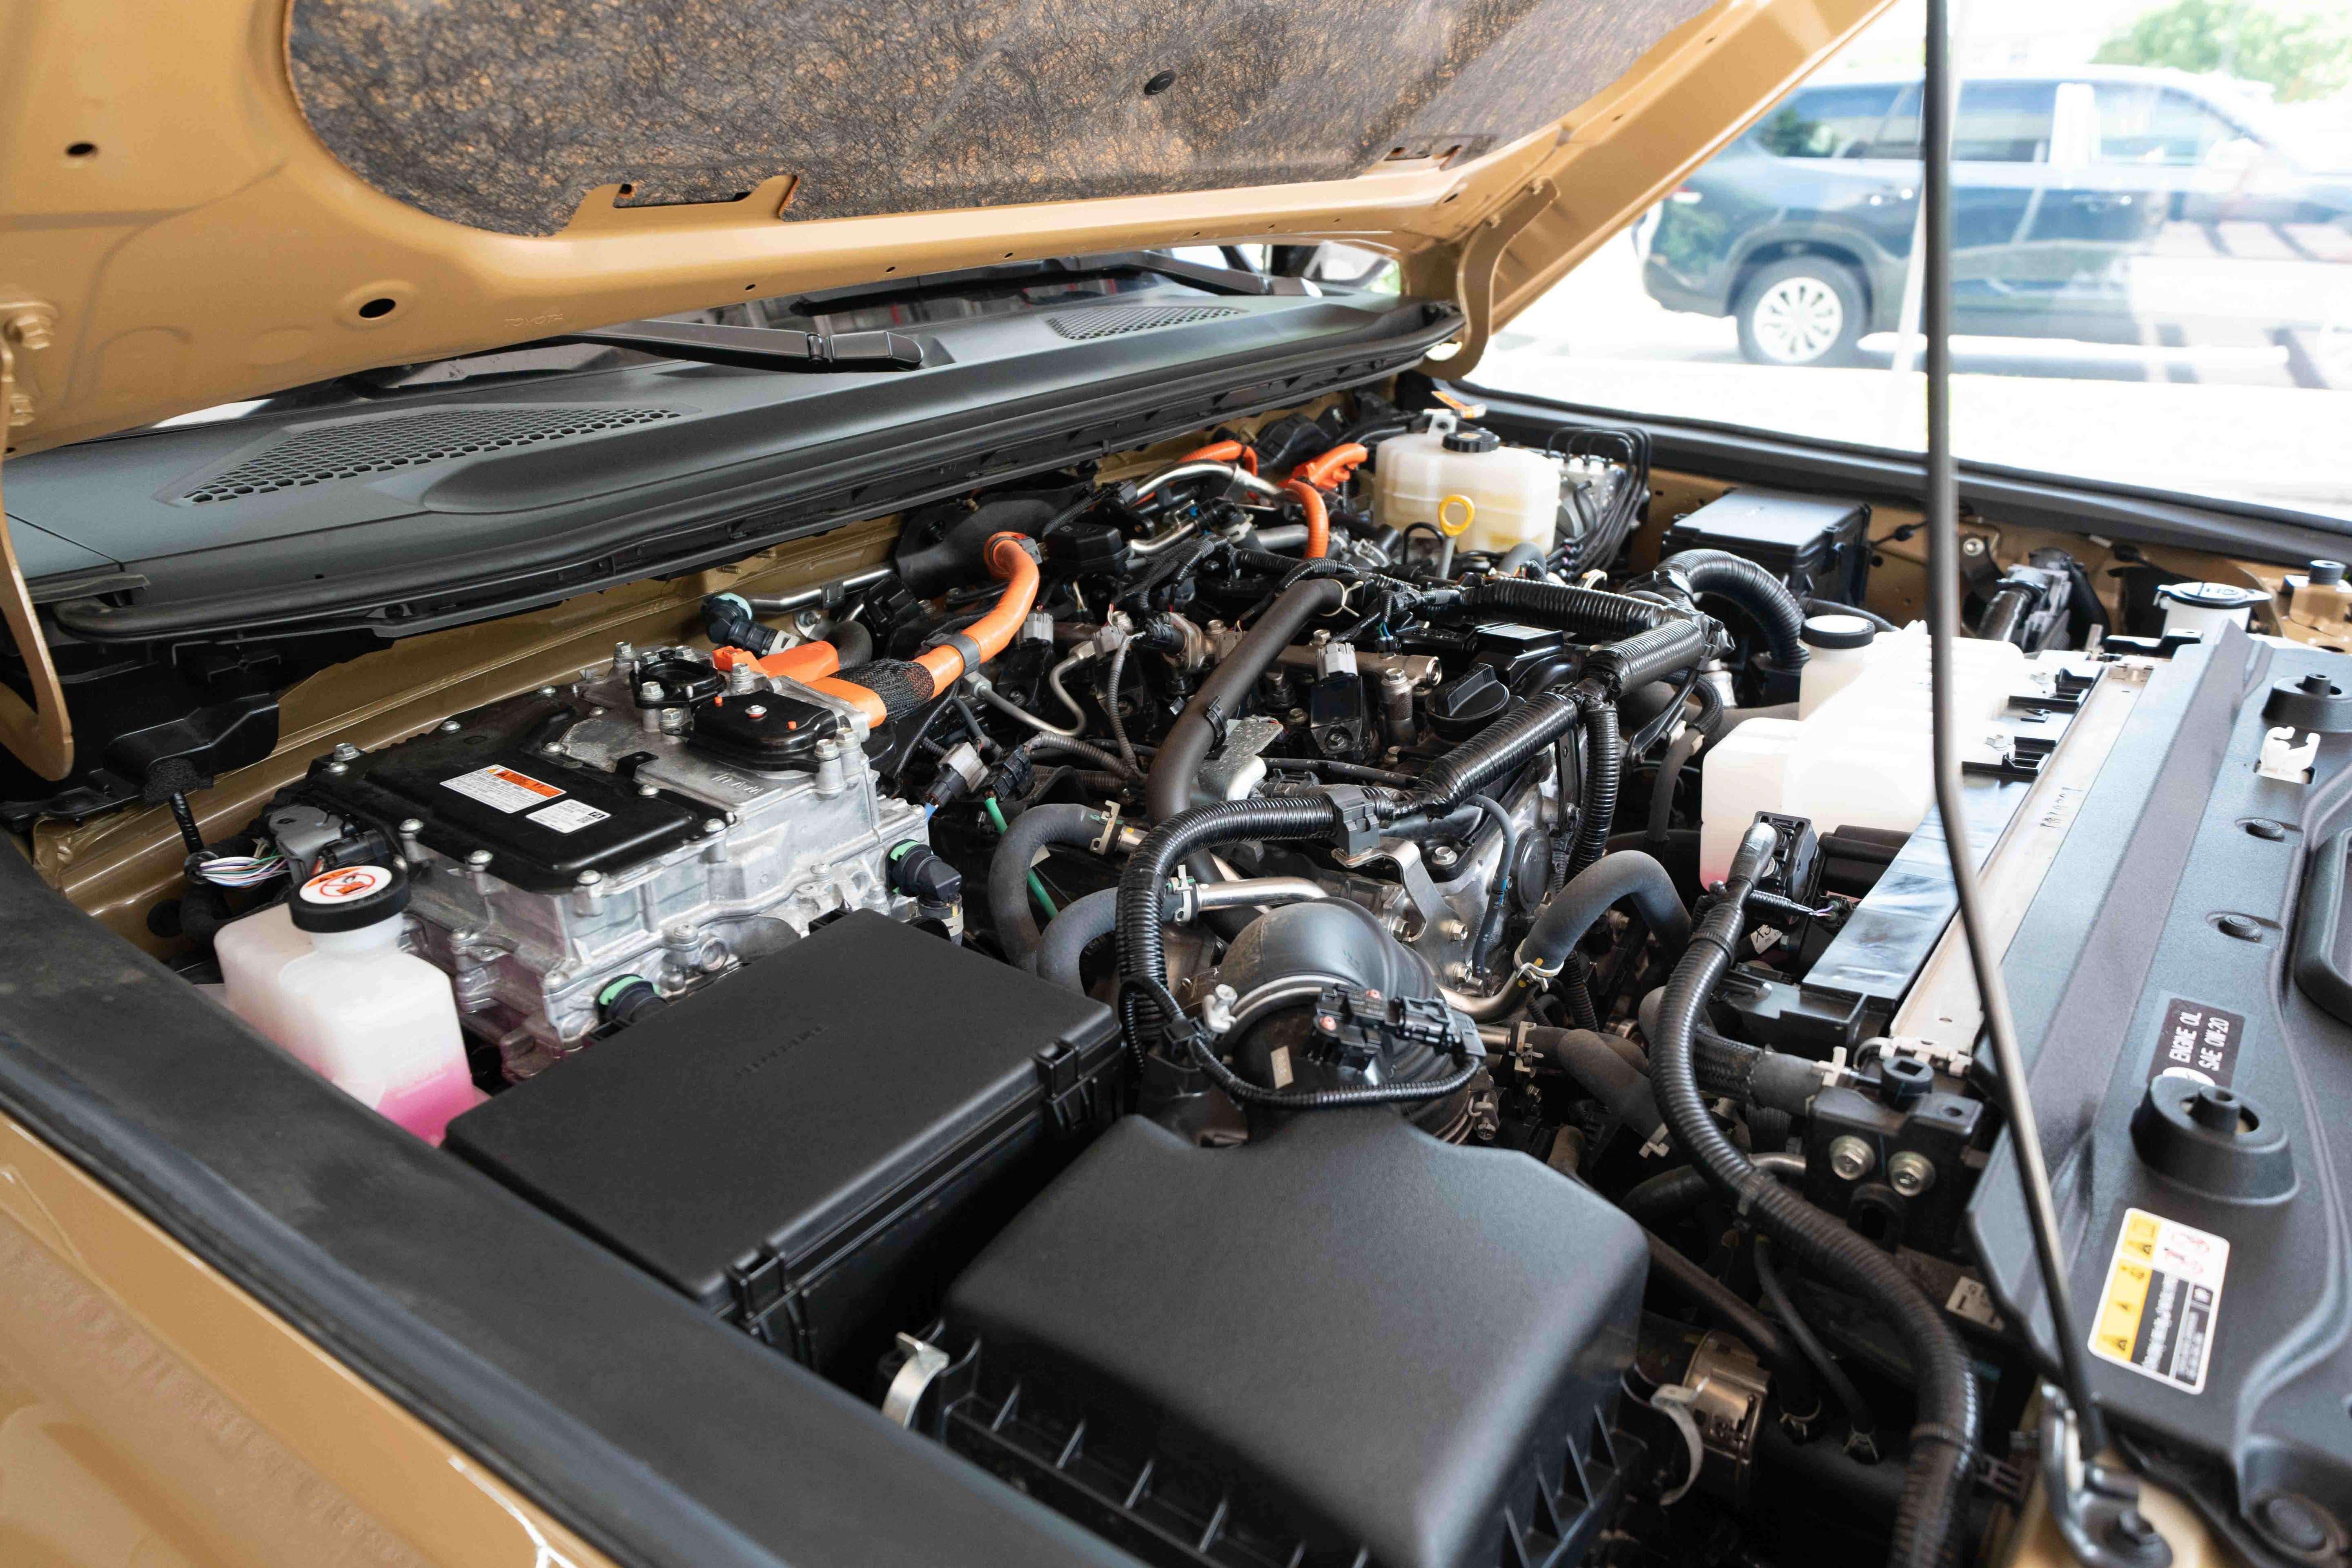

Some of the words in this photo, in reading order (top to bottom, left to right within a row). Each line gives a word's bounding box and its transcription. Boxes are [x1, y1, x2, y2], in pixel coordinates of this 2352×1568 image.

[2179, 1011, 2202, 1027] OIL
[2204, 1017, 2230, 1047] 0W-20
[2169, 1026, 2197, 1063] ENGINE
[2198, 1047, 2223, 1071] SAE
